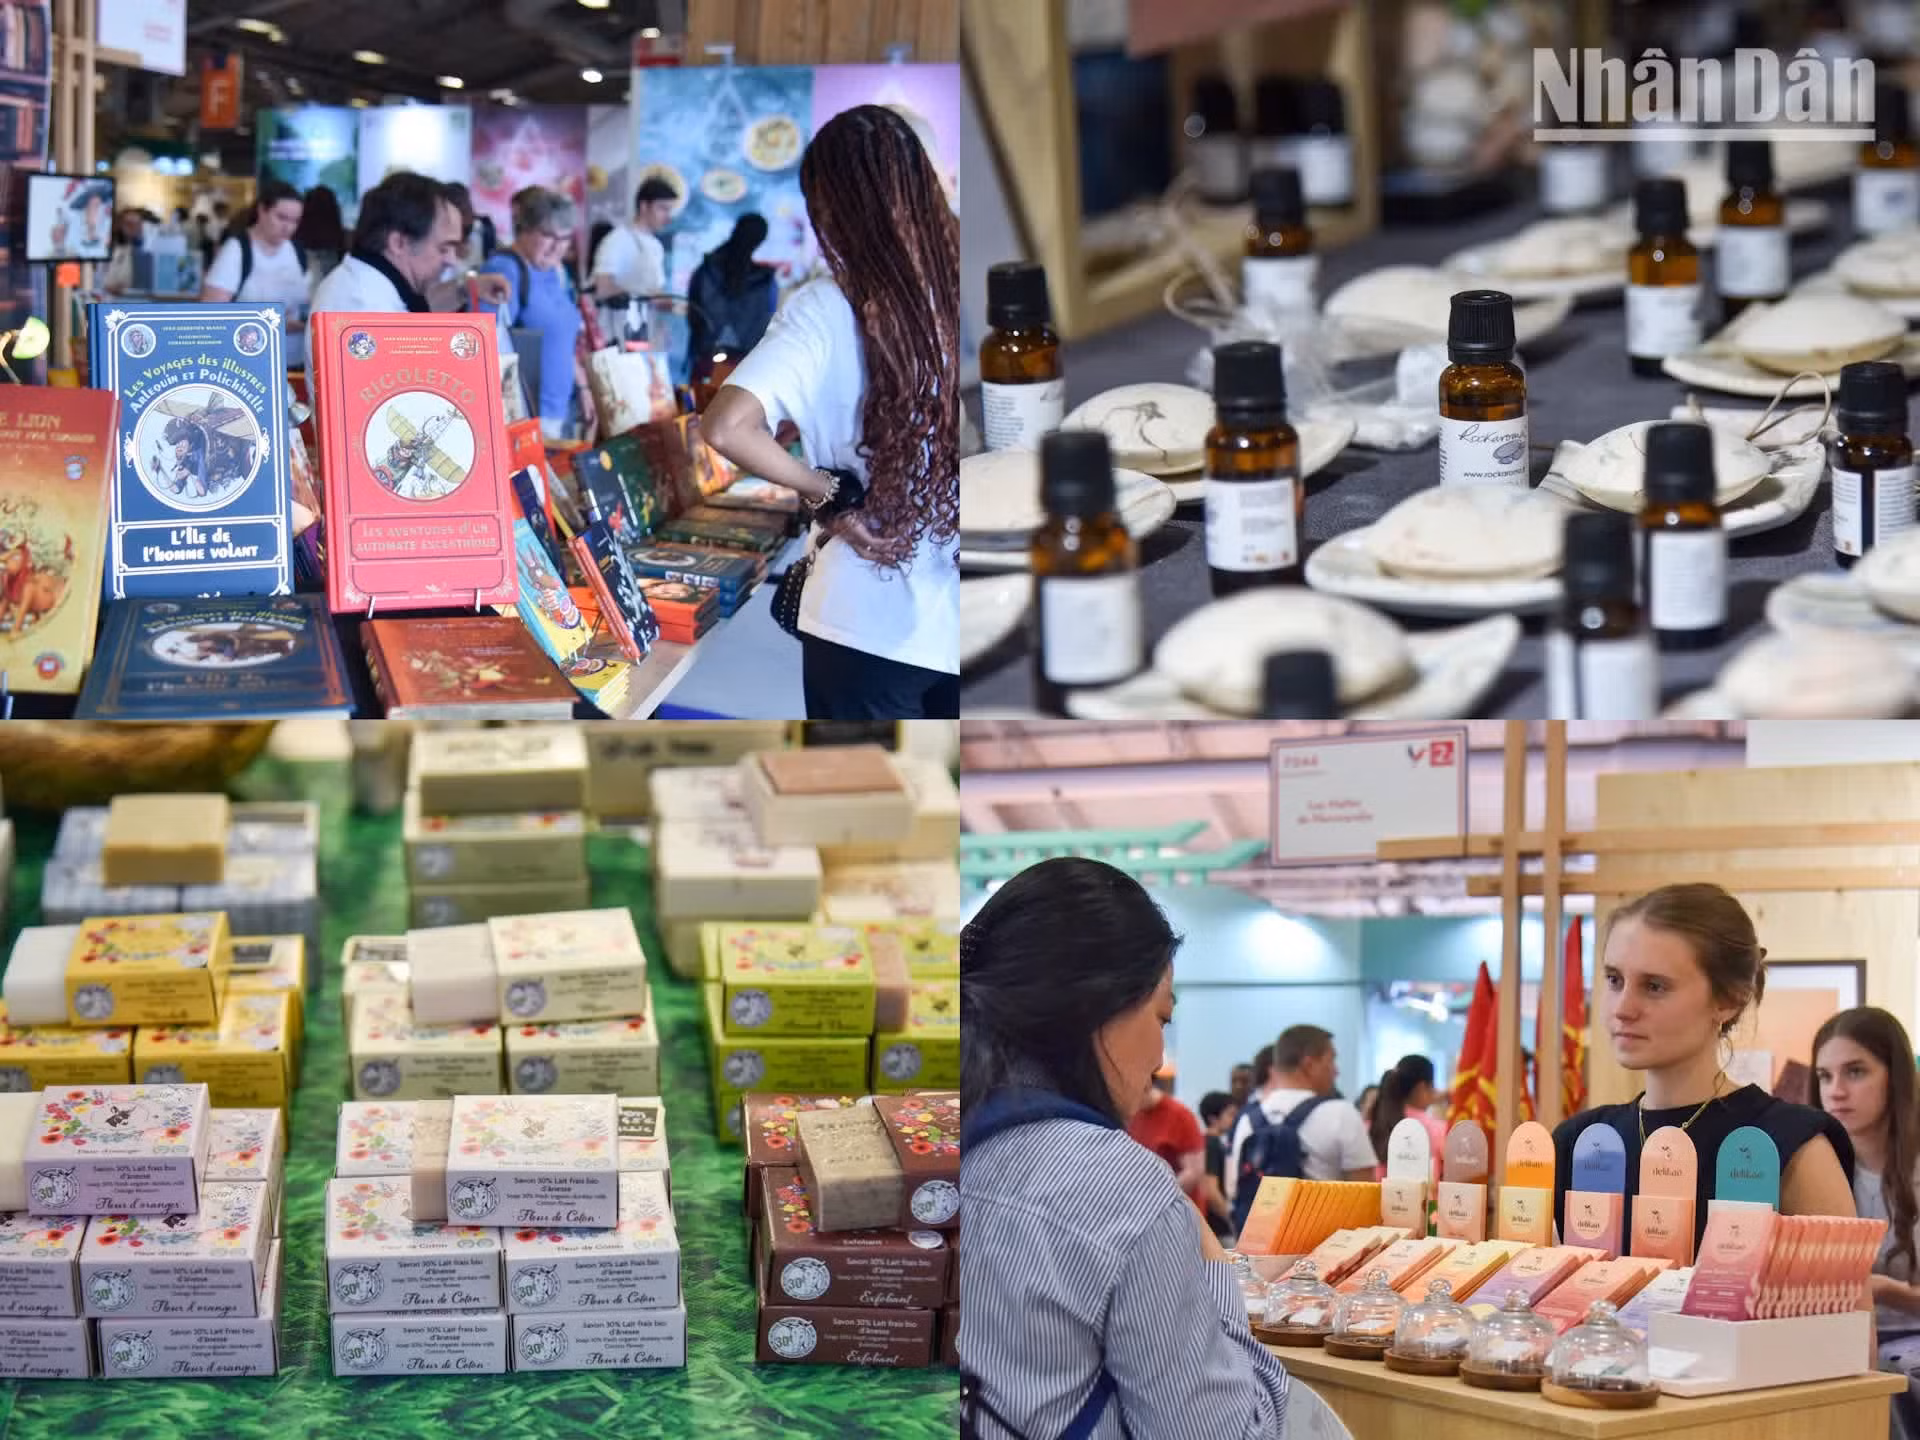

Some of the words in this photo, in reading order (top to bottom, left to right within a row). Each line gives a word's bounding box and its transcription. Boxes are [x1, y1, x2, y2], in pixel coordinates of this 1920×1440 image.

[361, 368, 477, 404] RIGOLETTO
[517, 1208, 548, 1222] Fleur
[552, 1211, 562, 1221] de
[566, 1209, 594, 1223] Coton
[402, 1292, 433, 1305] Fleur
[438, 1293, 447, 1304] de
[578, 1293, 609, 1305] Fleur
[613, 1294, 622, 1304] de
[407, 1358, 437, 1370] Fleur
[442, 1359, 450, 1369] de
[456, 1357, 483, 1370] Coton
[586, 1352, 616, 1364] Fleur
[620, 1353, 630, 1363] de
[634, 1352, 662, 1363] Coton
[846, 1350, 899, 1365] Exfoliant
